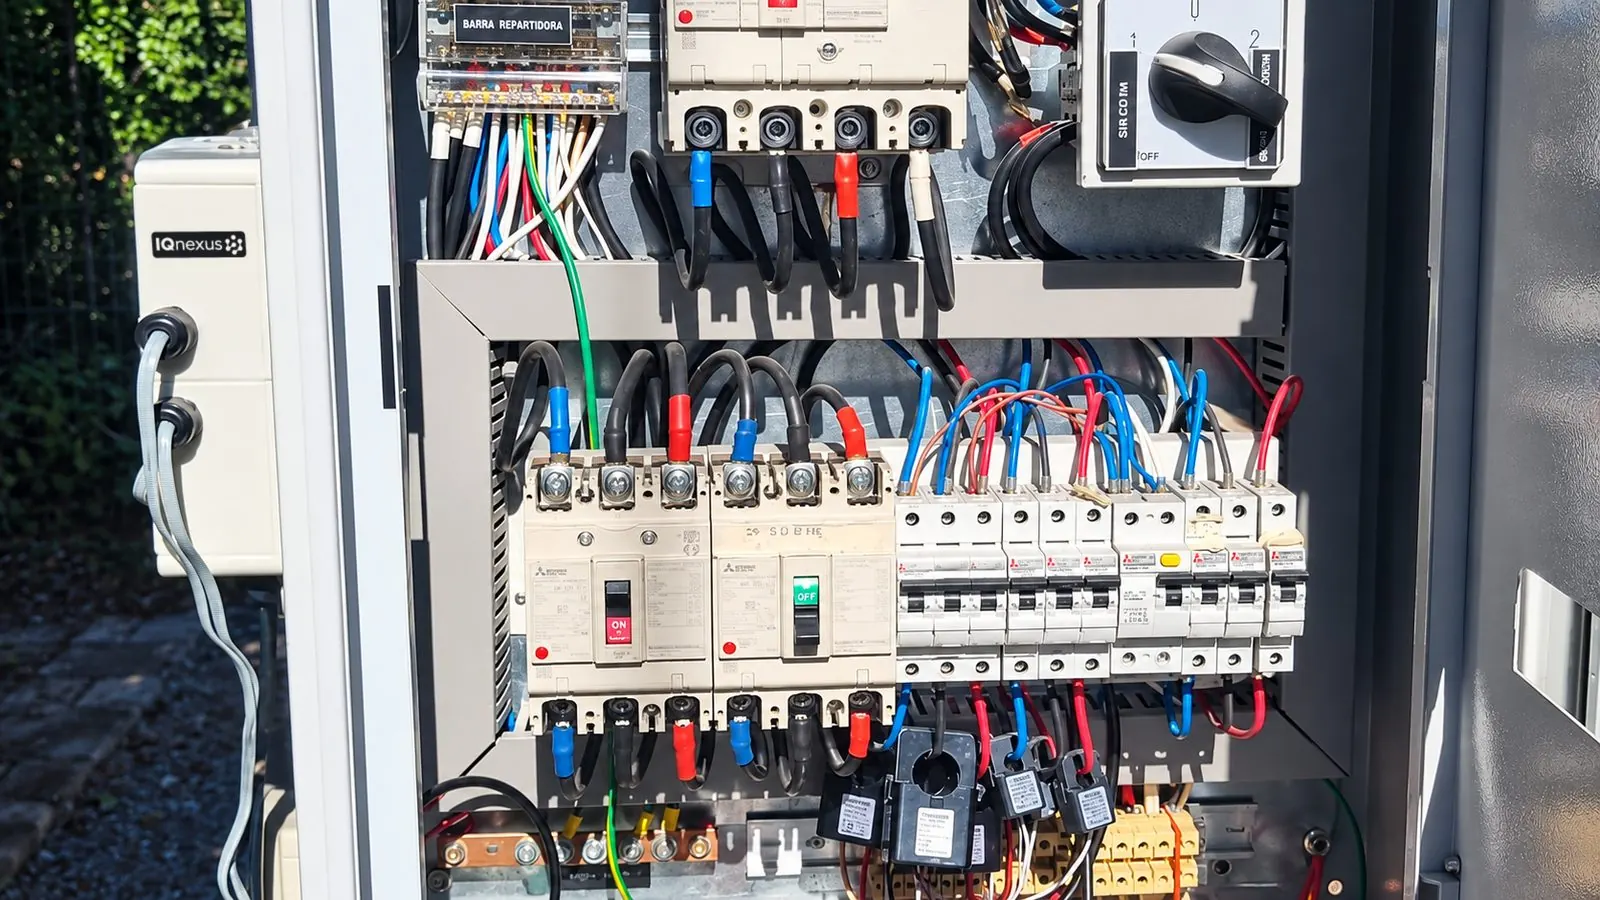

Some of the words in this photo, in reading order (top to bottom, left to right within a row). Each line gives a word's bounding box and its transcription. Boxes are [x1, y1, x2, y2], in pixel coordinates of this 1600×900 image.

[462, 19, 495, 29] BARRA
[499, 20, 564, 31] REPARTIDORA
[1249, 29, 1260, 49] 2
[155, 237, 223, 251] IQnexus
[797, 592, 816, 601] OFF
[611, 620, 627, 630] ON
